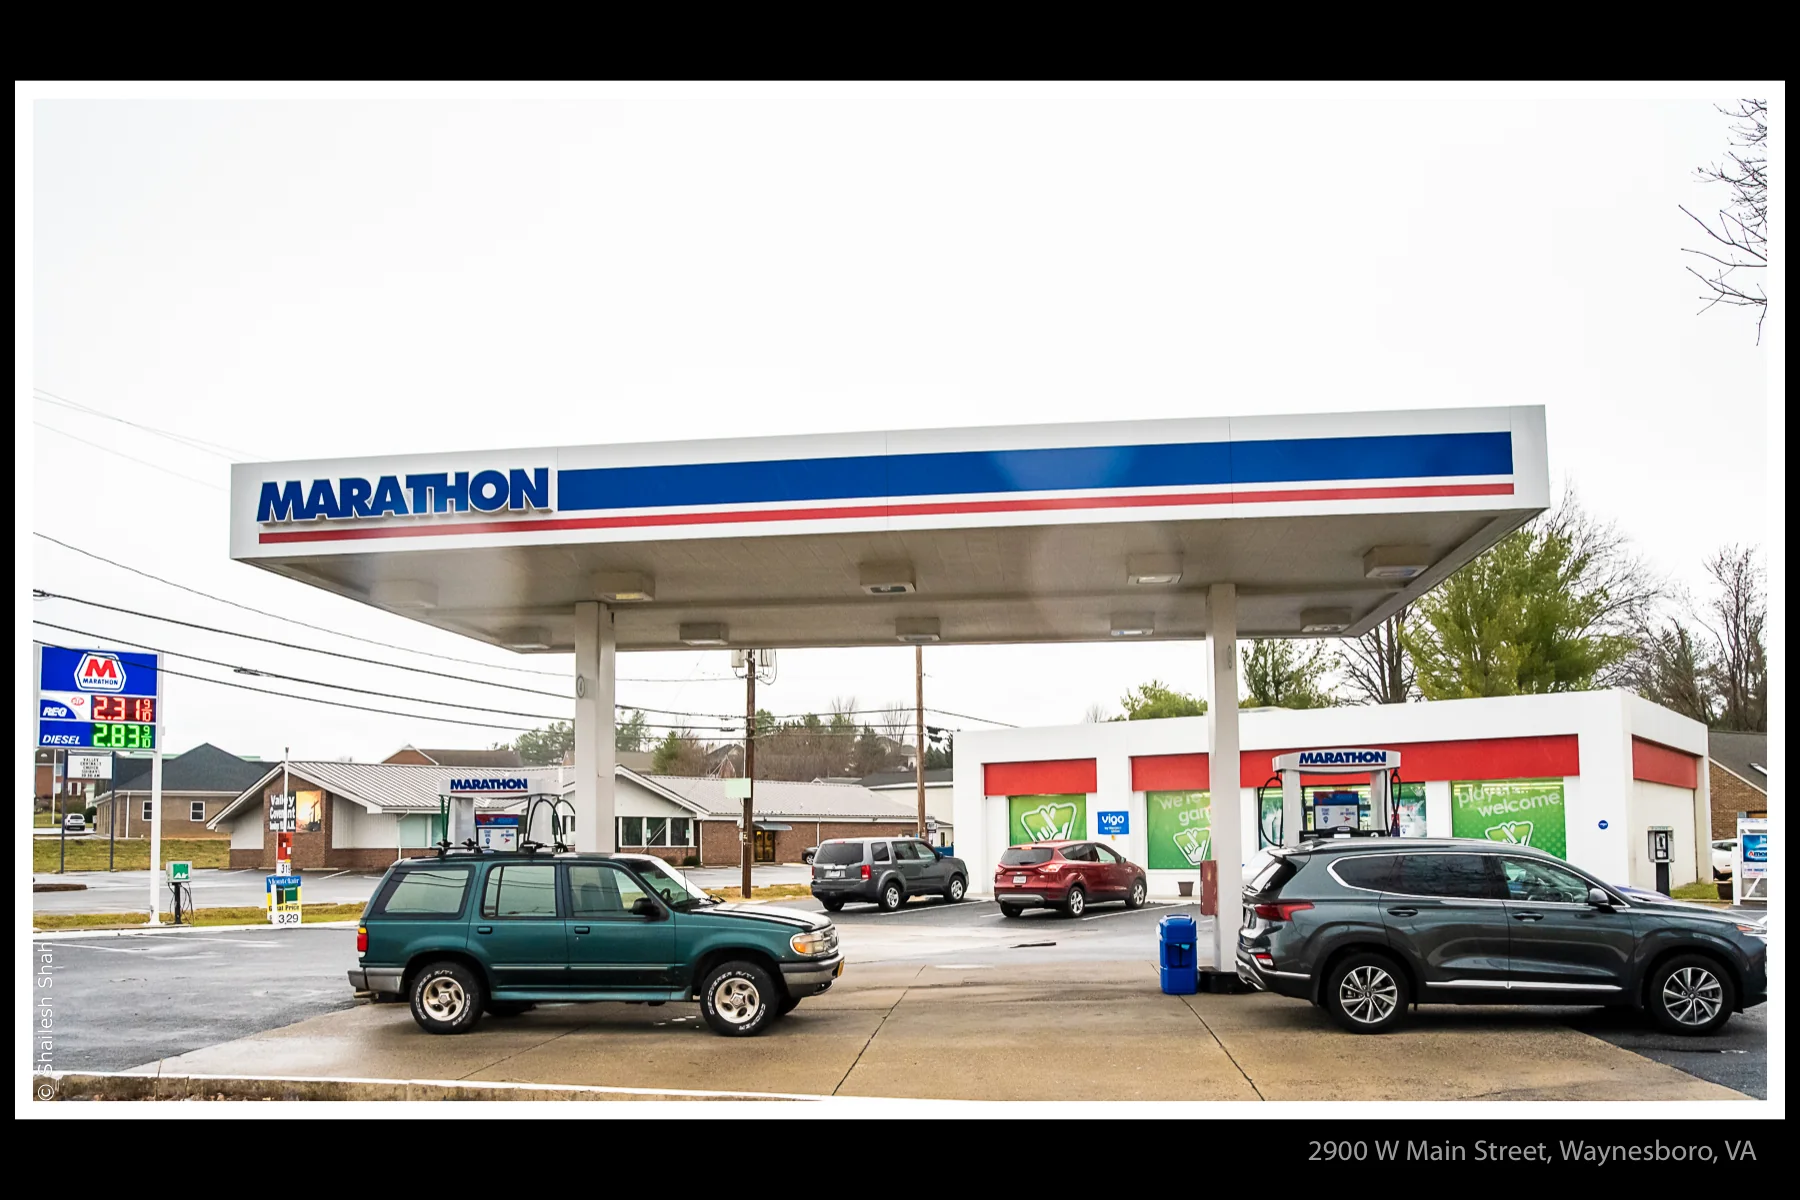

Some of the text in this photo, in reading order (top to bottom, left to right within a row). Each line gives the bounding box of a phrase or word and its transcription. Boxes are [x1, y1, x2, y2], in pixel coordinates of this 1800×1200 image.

[256, 467, 550, 523] MARATHON
[82, 678, 119, 686] MARATHON
[43, 707, 67, 717] REG
[93, 696, 141, 721] 2.31
[42, 735, 81, 745] DIESEL
[93, 724, 140, 748] 2.83
[1299, 751, 1387, 765] MARATHON
[450, 778, 528, 790] MARATHON
[1101, 813, 1125, 826] vigo
[285, 904, 299, 912] Price
